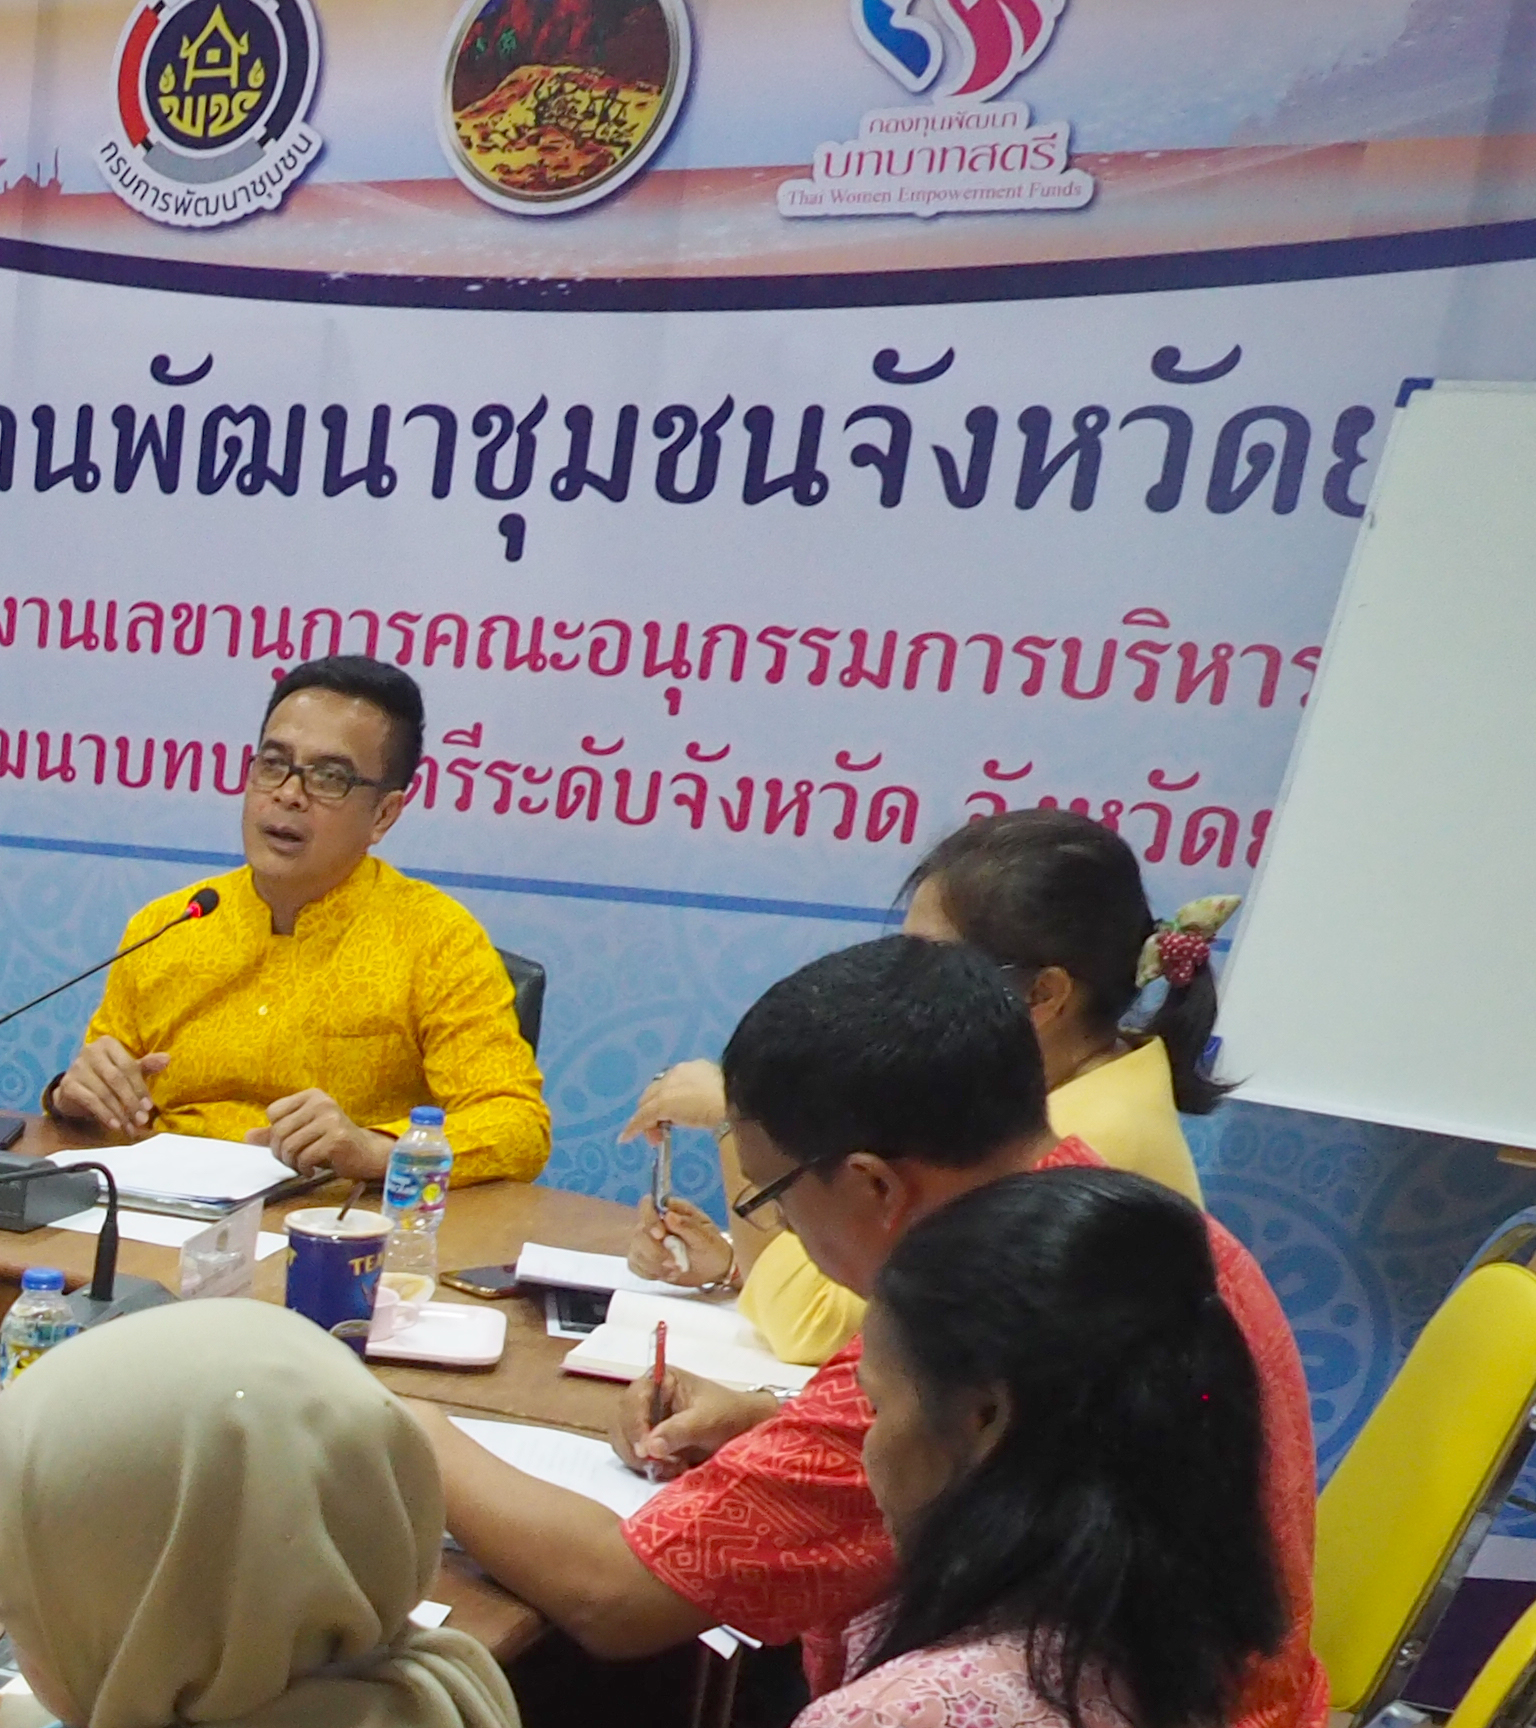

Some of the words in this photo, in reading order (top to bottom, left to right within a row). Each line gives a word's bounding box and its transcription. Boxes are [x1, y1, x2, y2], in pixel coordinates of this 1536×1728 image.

[868, 110, 1019, 138] กองทุนพัฒนา
[100, 132, 313, 218] กรมการพัฒนาชุมชน
[823, 132, 1059, 180] บทบาทสตรี
[787, 188, 825, 207] Thai
[830, 187, 892, 206] Women
[897, 182, 1024, 205] Empowerment
[1028, 180, 1084, 199] Funds
